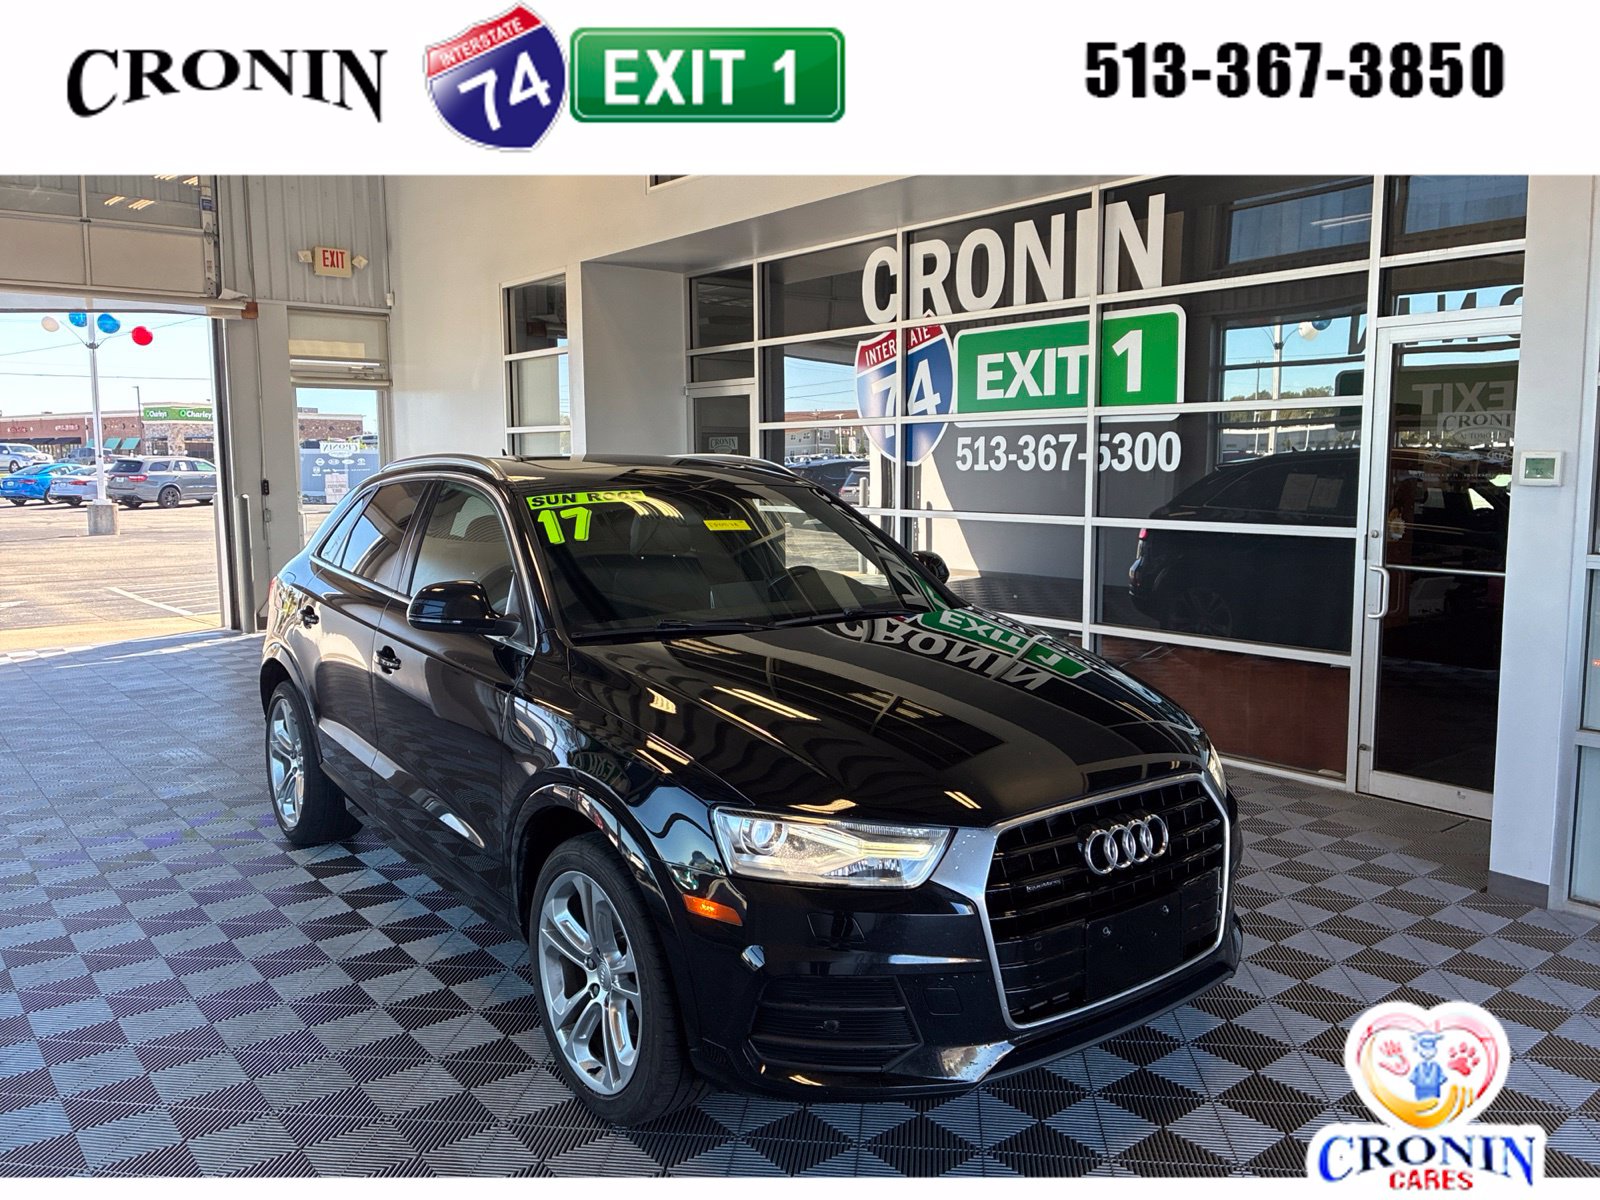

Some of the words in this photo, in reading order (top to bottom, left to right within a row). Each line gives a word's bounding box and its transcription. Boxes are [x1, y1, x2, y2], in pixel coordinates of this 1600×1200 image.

[322, 249, 346, 269] EXIT
[862, 193, 1166, 325] CRONIN
[865, 327, 931, 367] INTERATE
[977, 344, 1090, 400] EXIT
[1112, 329, 1143, 393] 1
[872, 359, 941, 438] 74
[956, 431, 1182, 472] 513-367-5300
[531, 492, 577, 507] SUN
[537, 506, 592, 544] 17
